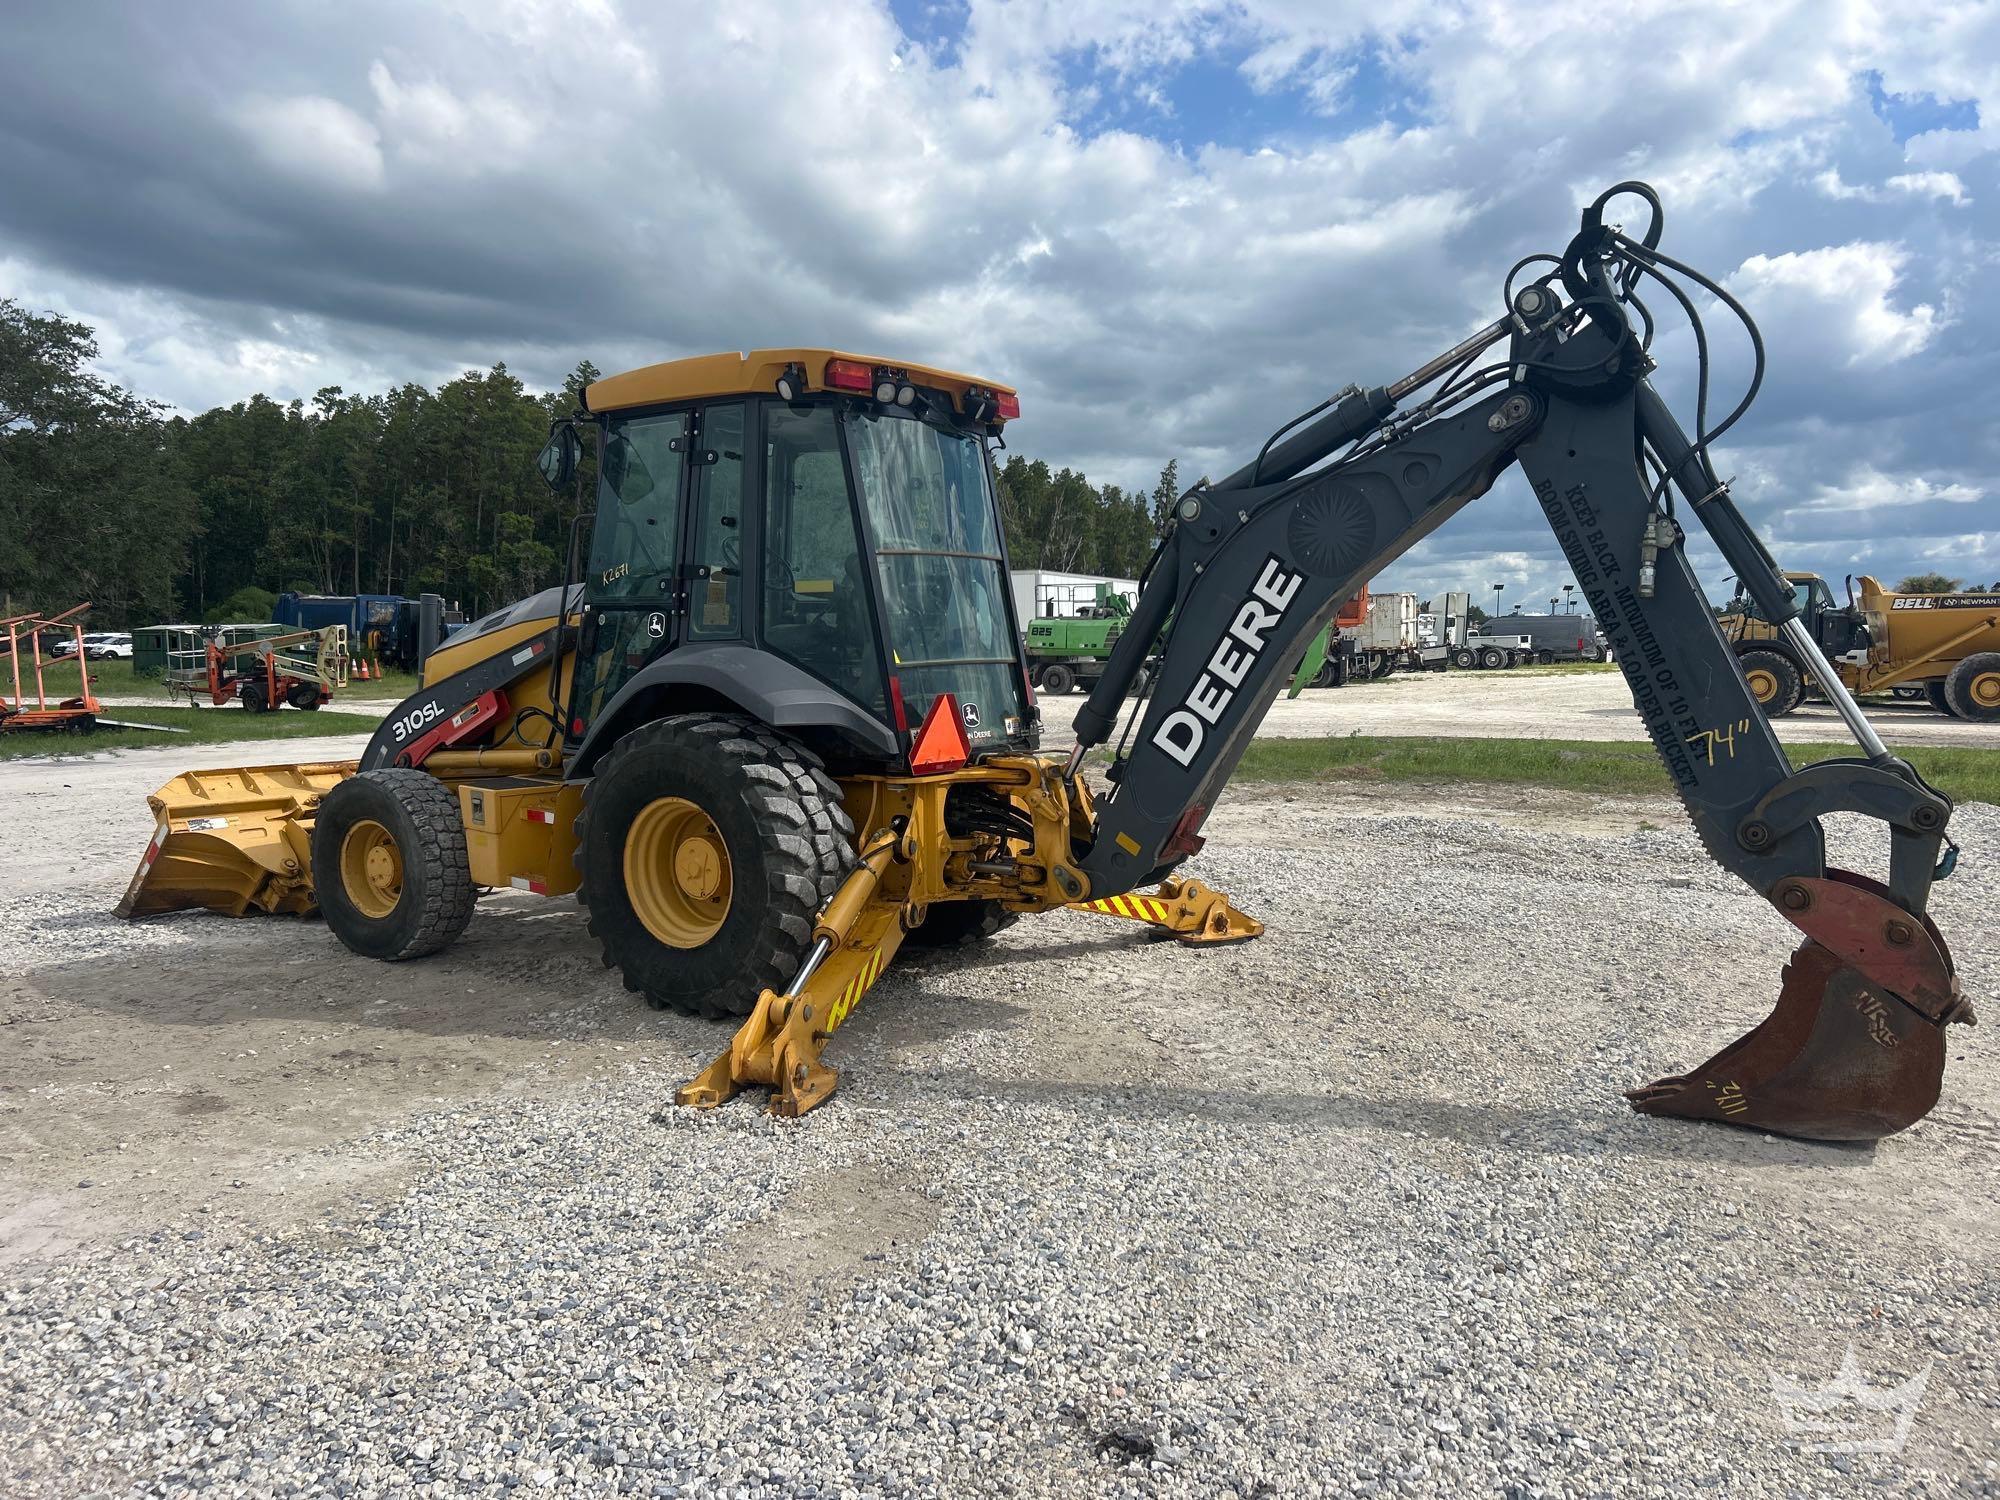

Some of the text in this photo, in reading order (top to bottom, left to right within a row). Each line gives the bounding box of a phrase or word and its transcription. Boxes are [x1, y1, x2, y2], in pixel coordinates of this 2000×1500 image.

[1565, 485, 1597, 528] KEEP
[1588, 528, 1621, 579] BACK
[602, 563, 629, 587] K2671
[1892, 598, 1933, 609] BELL
[1031, 627, 1053, 637] 825
[1536, 478, 1698, 788] BOOM SWING AREA & LOADER BUCKET
[1616, 585, 1666, 668] MINIMUM
[1152, 558, 1303, 767] DEERE
[1655, 664, 1679, 693] OF
[392, 700, 445, 742] 310SL
[1669, 694, 1690, 716] 10
[973, 730, 992, 739] DEERE
[1678, 717, 1711, 762] FEET
